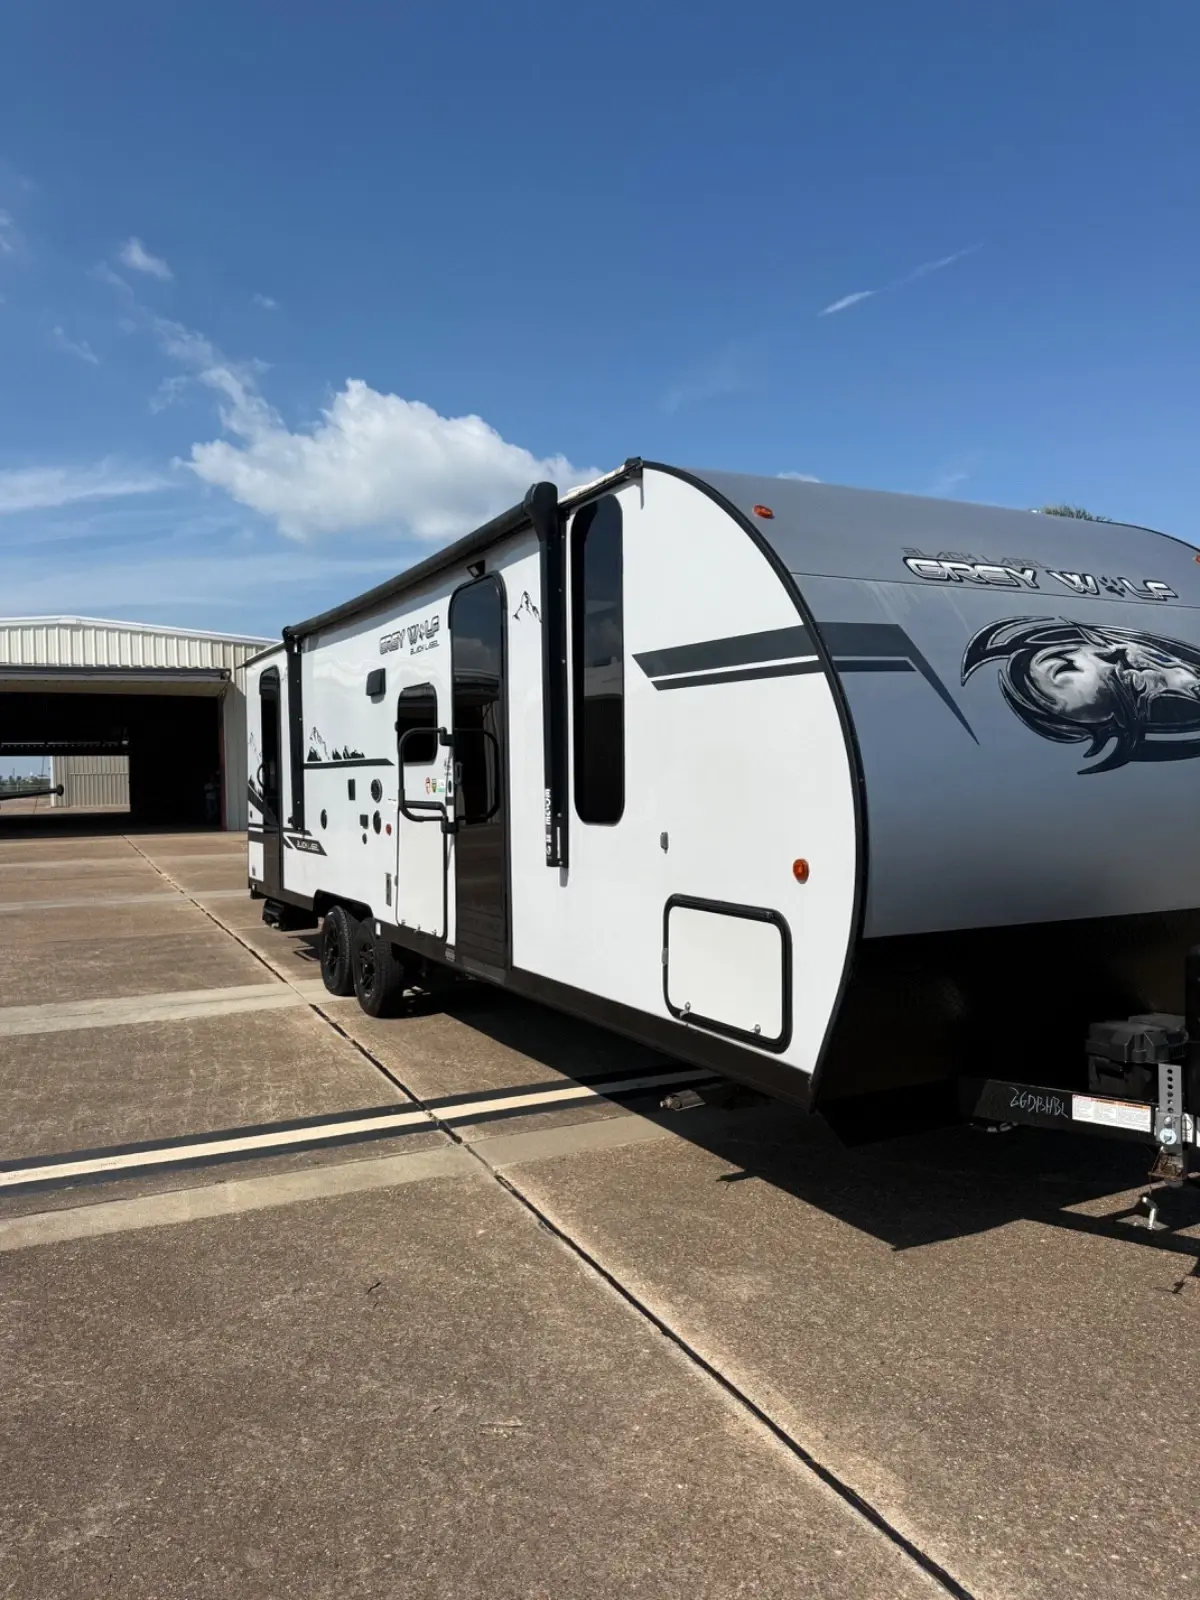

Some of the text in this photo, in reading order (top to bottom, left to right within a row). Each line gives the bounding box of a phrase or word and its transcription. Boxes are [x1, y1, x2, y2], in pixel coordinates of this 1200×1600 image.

[901, 547, 1050, 569] BLACK LABEL
[902, 556, 1041, 590] GREY
[380, 629, 405, 655] GREY
